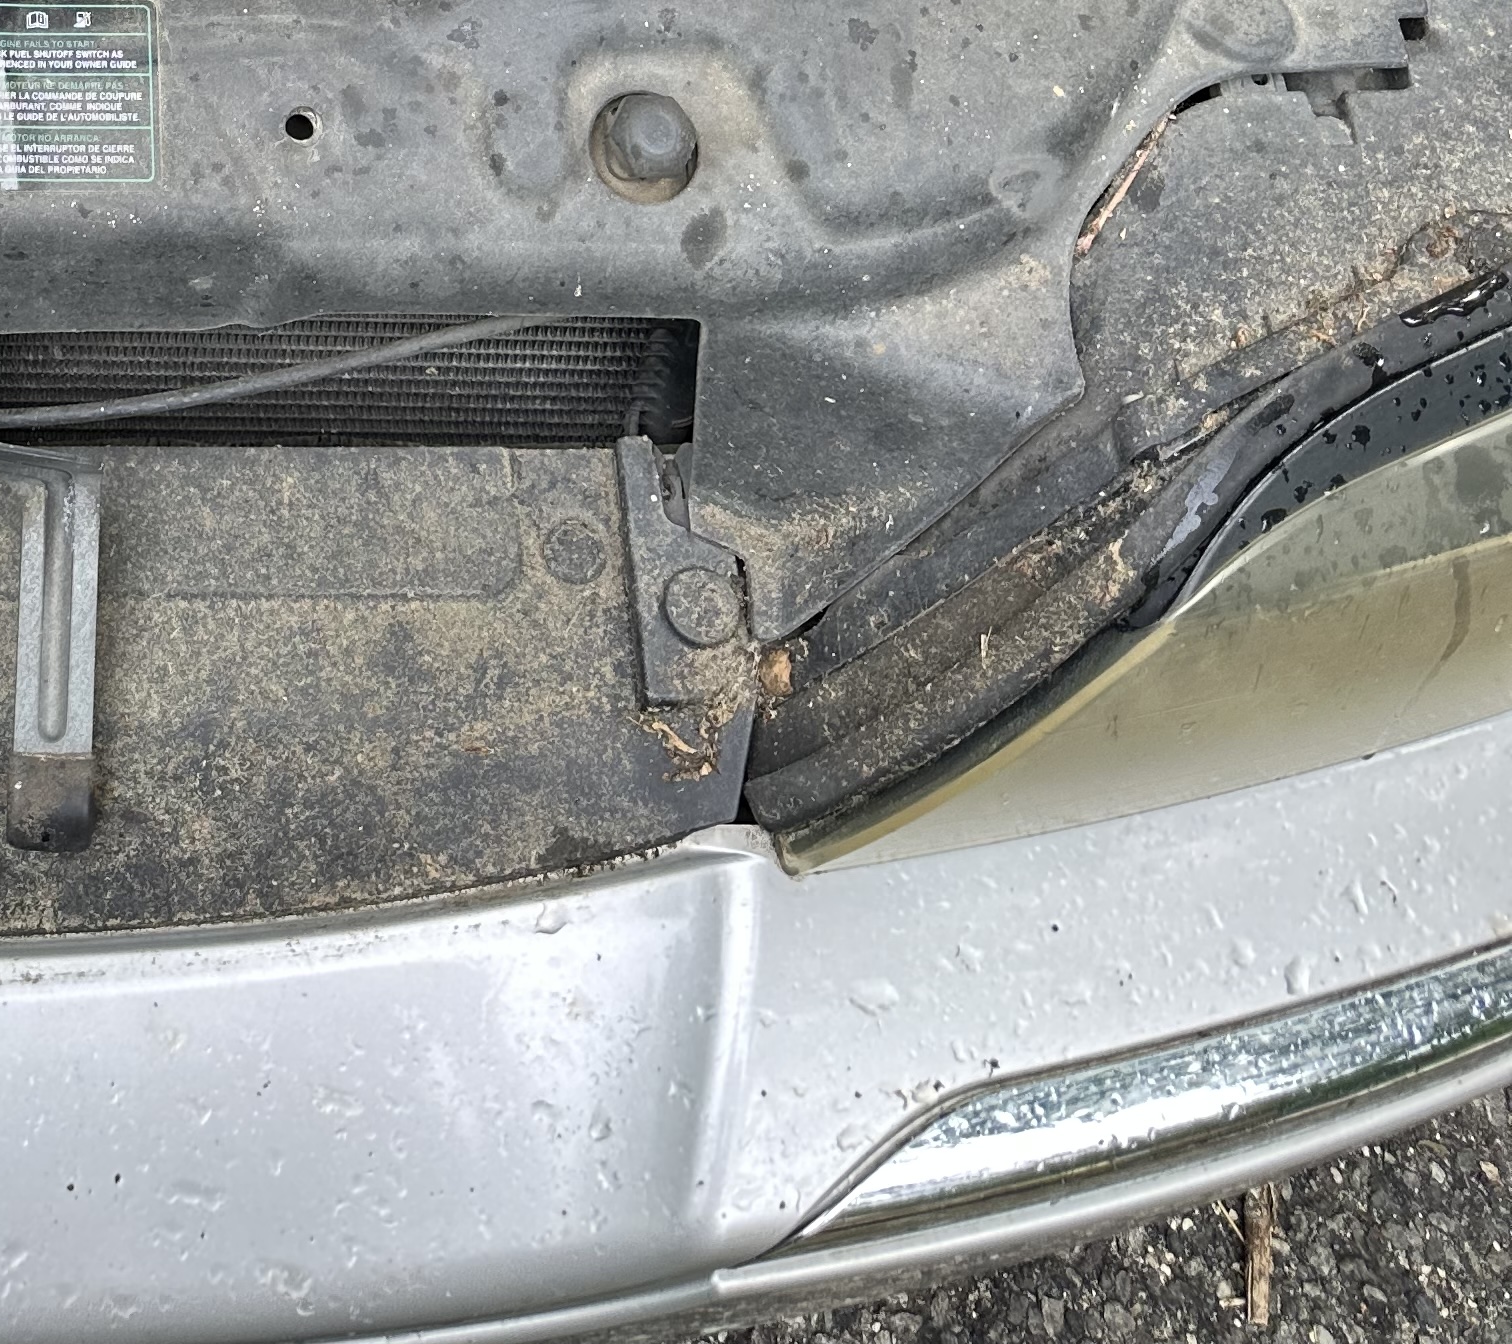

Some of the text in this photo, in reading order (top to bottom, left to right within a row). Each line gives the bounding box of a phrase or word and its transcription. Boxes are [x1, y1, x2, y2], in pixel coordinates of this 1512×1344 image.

[23, 40, 50, 48] FAILS
[52, 40, 64, 48] TO
[9, 50, 32, 59] FUEL
[33, 50, 74, 59] SHUTOFF
[75, 50, 110, 59] SWITCH
[110, 50, 124, 58] AS
[37, 60, 47, 69] IN
[48, 60, 73, 69] YOUR
[74, 60, 108, 69] OWNER
[109, 60, 137, 69] GUIDE
[4, 81, 44, 90] MOTEUR
[45, 81, 57, 90] NE
[18, 92, 30, 100] LA
[31, 92, 83, 101] COMMANDE
[85, 92, 98, 100] DE
[99, 91, 142, 101] COUPURE
[49, 102, 83, 111] COMME
[3, 113, 15, 122] LE
[16, 112, 45, 121] GUIDE
[46, 112, 58, 121] DE
[2, 133, 36, 143] MOTOR
[38, 133, 51, 143] NO
[10, 144, 22, 153] EL
[23, 144, 86, 153] INTERRUPTOR
[88, 144, 100, 153] DE
[102, 144, 135, 153] CIERRE
[61, 154, 89, 164] COMO
[90, 154, 103, 163] SE
[104, 154, 135, 164] INDICA
[28, 165, 46, 174] DEL
[47, 165, 107, 175] PROPIETARIO
